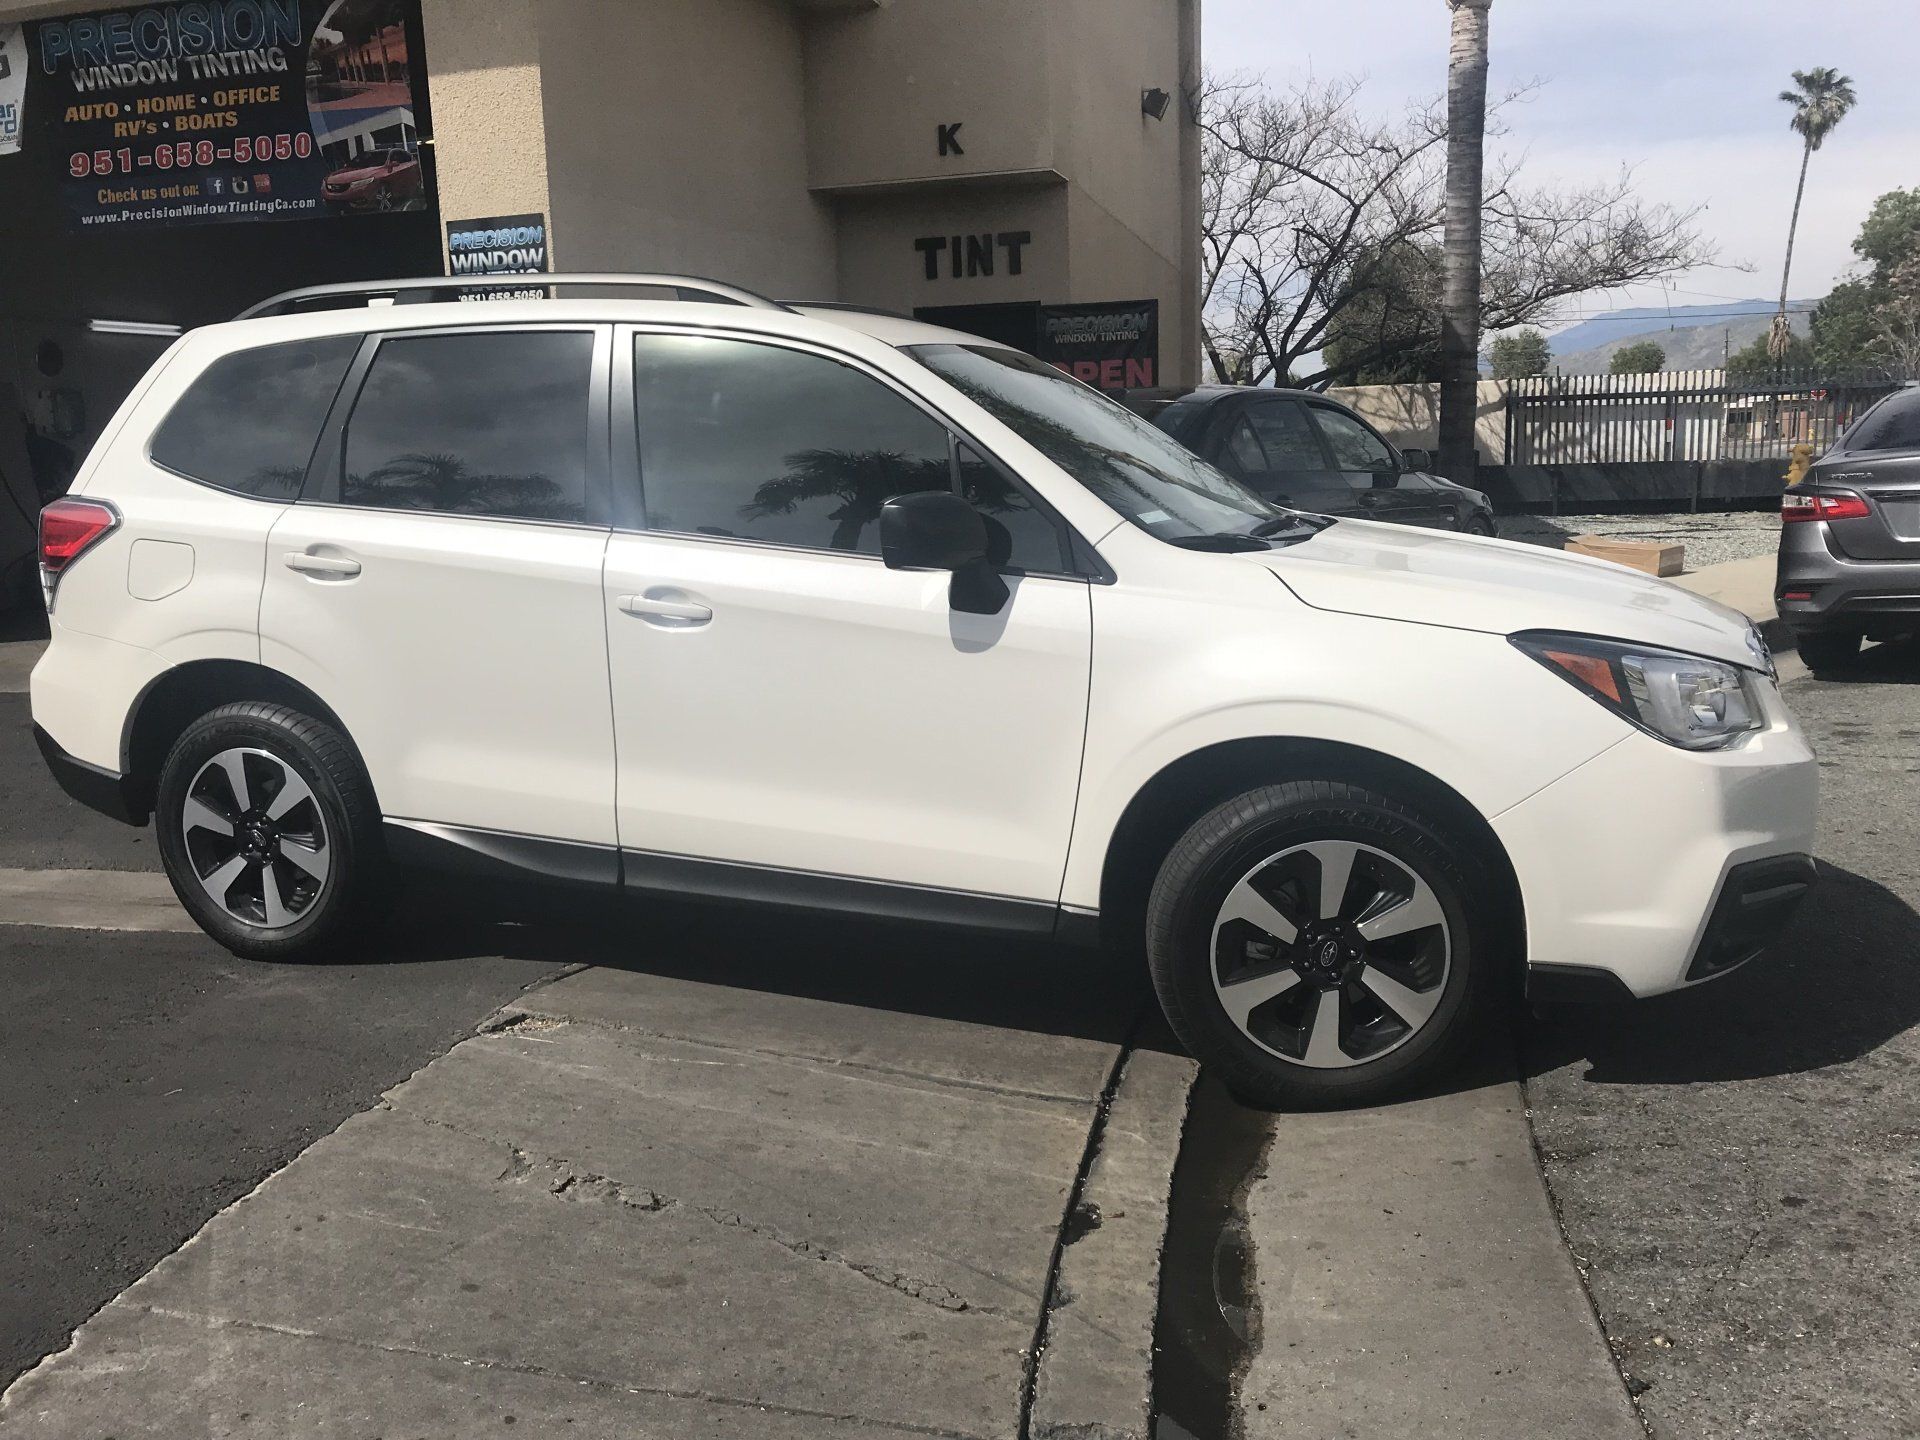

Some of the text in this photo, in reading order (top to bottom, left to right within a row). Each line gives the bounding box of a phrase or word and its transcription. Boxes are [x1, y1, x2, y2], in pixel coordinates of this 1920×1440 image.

[39, 0, 302, 74] PRECISION
[71, 47, 289, 92] WINDOW TINTING
[64, 85, 280, 122] AUTO HOME OFFICE
[114, 111, 239, 138] RV's BOATS
[938, 122, 965, 156] K
[69, 132, 312, 177] 951-658-5050
[97, 183, 200, 204] Check us out on:
[82, 198, 316, 225] www.PrecisionWindowTintingCa.com
[450, 226, 543, 251] PRECISION
[451, 247, 544, 273] WINDOW
[915, 231, 1031, 280] TINT
[1046, 312, 1149, 337] PRECISION
[1055, 331, 1139, 344] WINDOW TINTING
